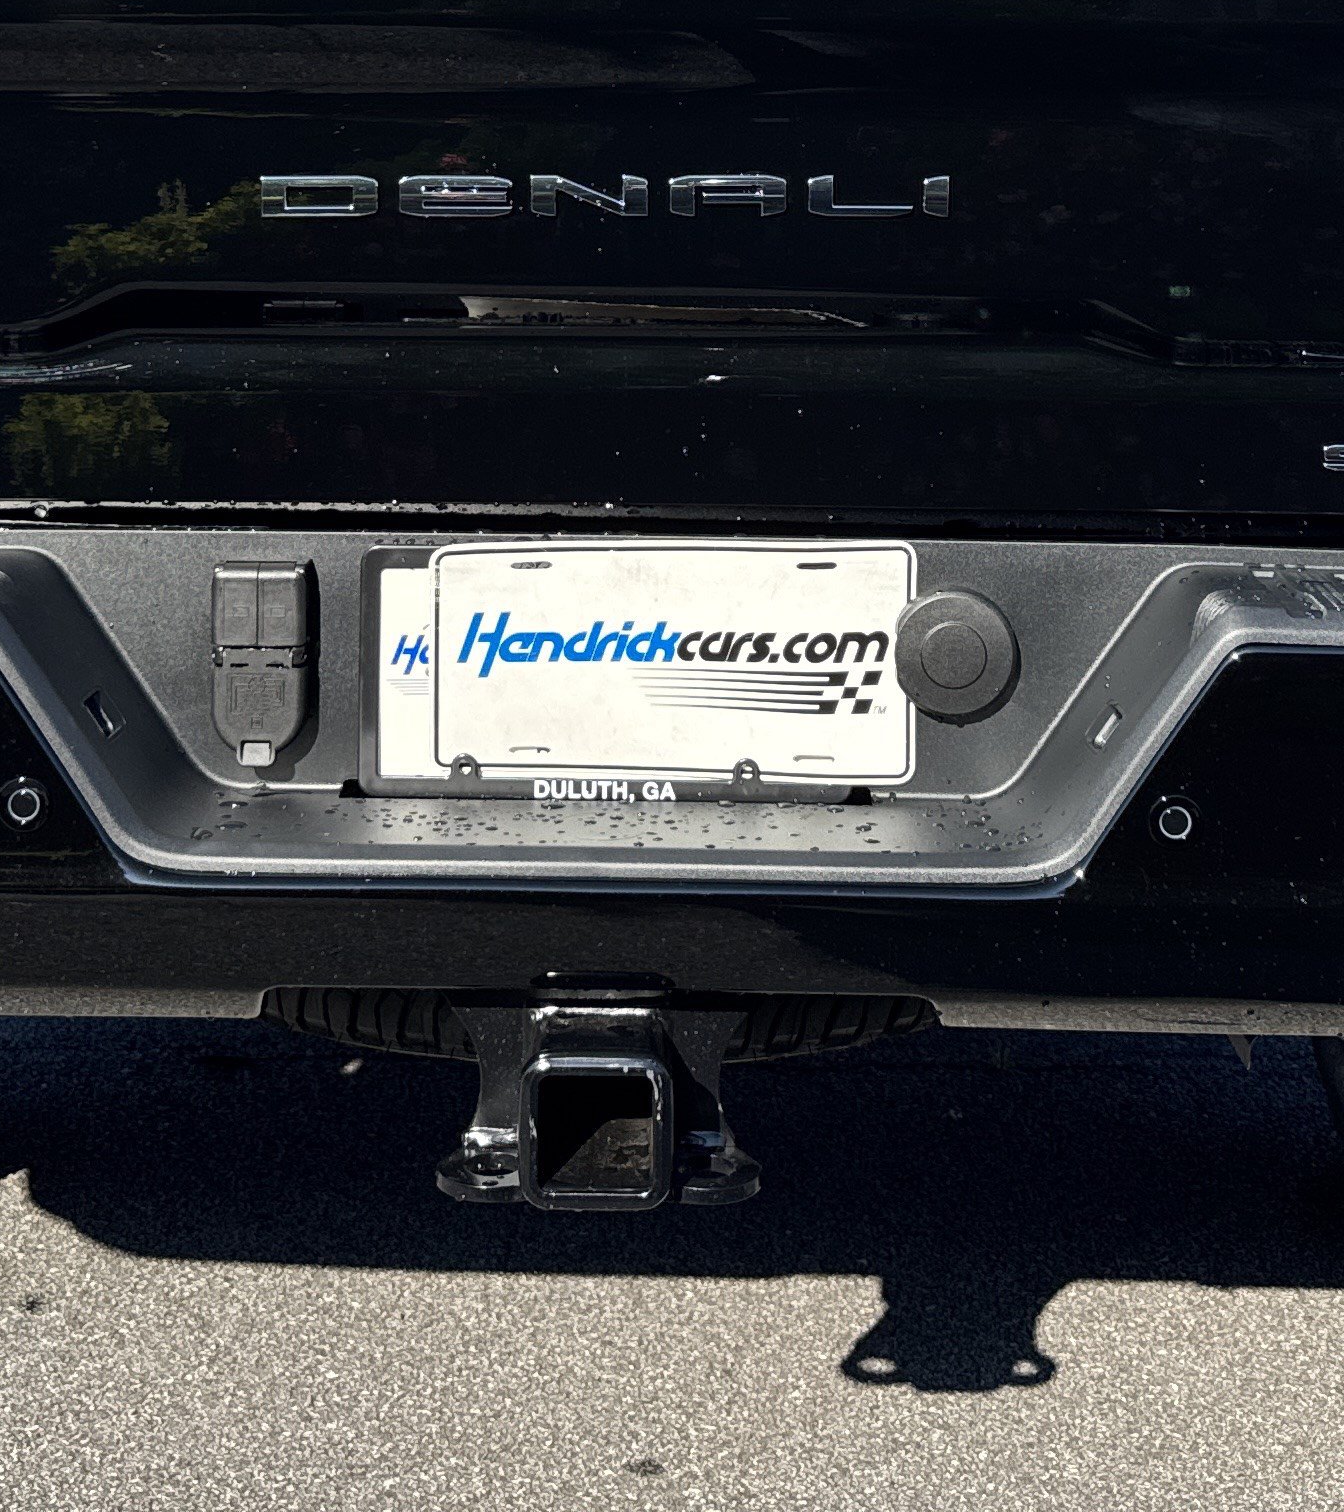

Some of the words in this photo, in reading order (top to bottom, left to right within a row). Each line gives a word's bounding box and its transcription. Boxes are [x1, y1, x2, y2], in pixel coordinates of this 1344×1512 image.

[259, 173, 951, 218] DENALI
[456, 610, 890, 679] Hendrickcars.com
[872, 705, 888, 715] TM
[533, 779, 635, 803] DULUTH,
[642, 781, 676, 801] GA
